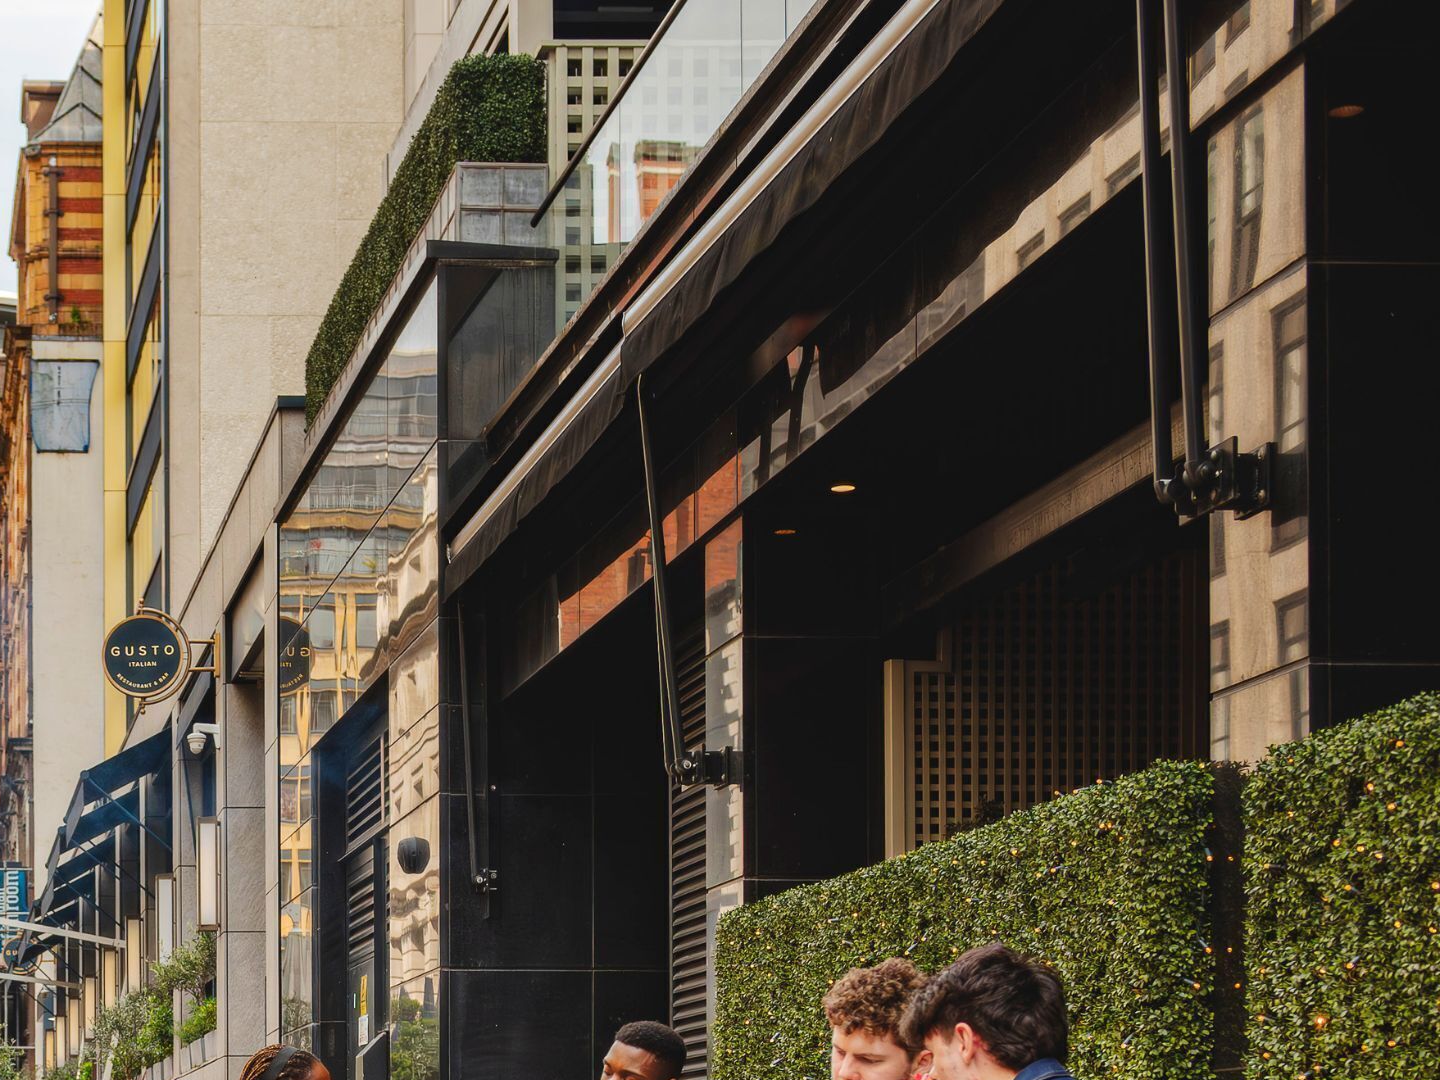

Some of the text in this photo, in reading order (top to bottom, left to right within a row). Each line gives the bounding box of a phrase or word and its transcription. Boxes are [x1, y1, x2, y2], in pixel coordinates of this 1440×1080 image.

[111, 645, 175, 656] GUSTO
[116, 673, 152, 688] RESTAURANT
[158, 672, 169, 683] BAR
